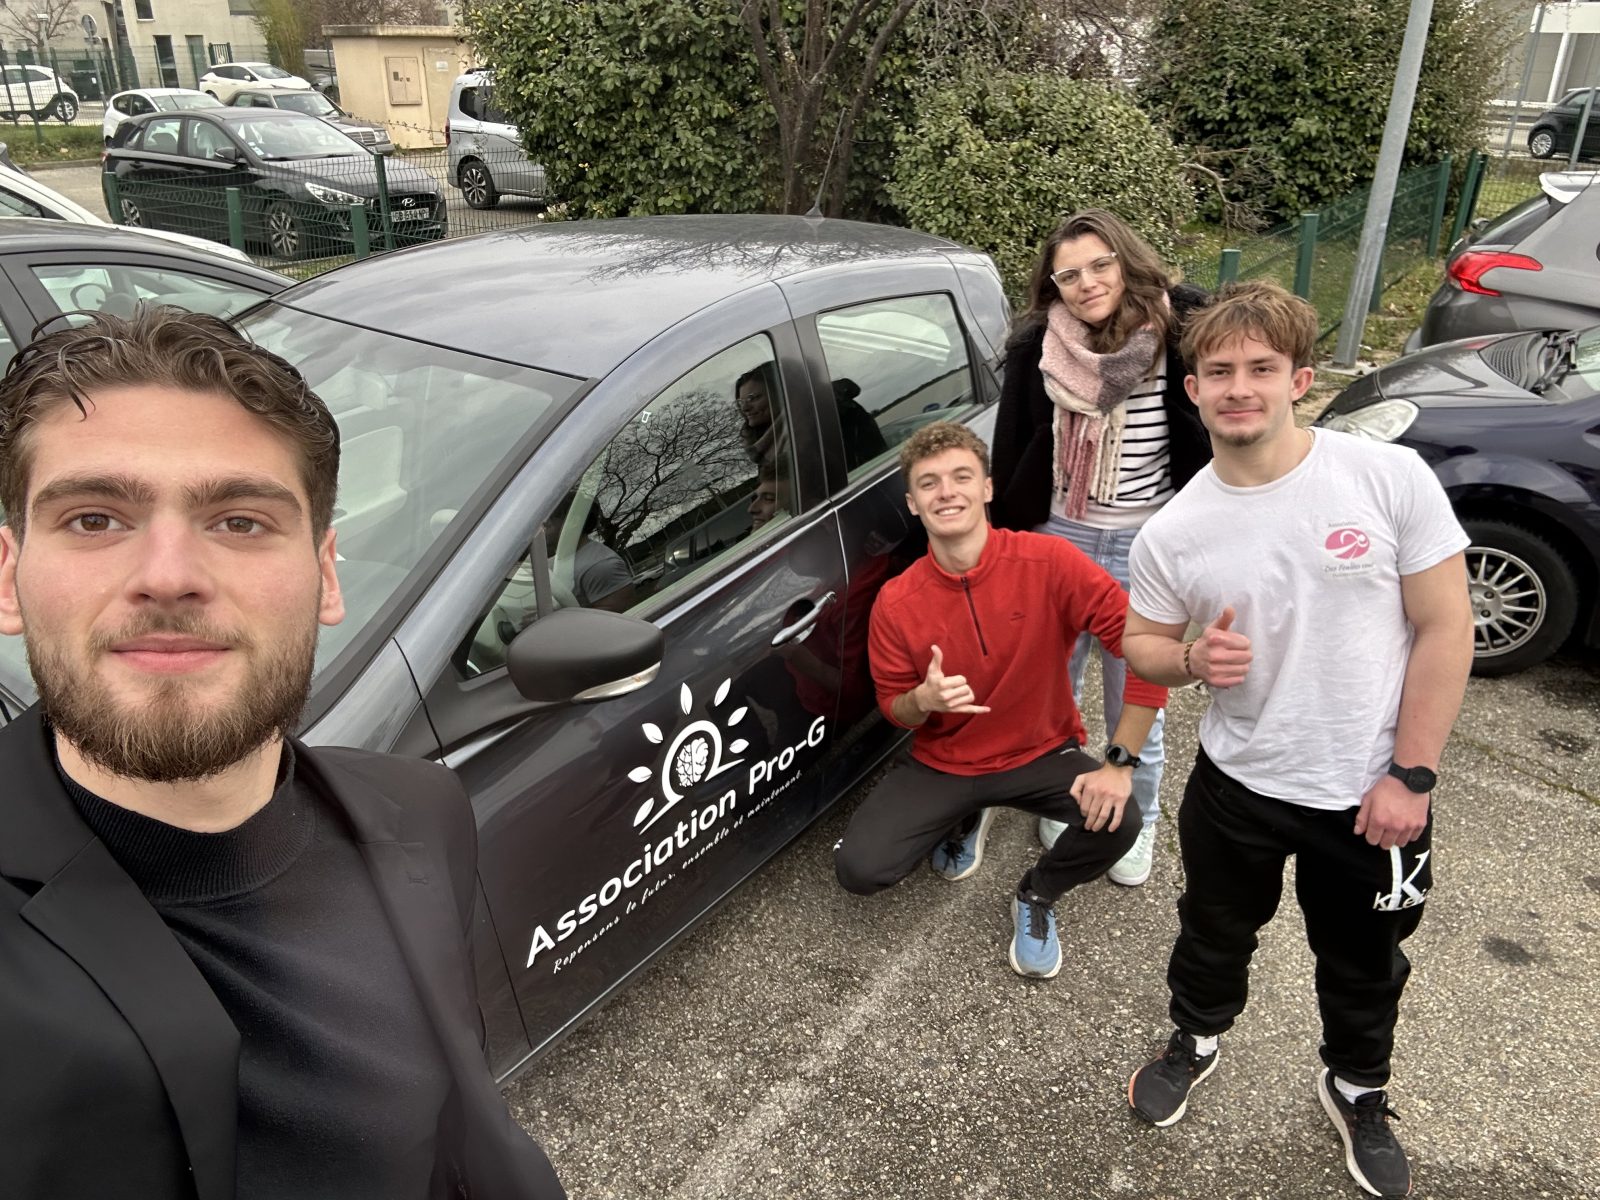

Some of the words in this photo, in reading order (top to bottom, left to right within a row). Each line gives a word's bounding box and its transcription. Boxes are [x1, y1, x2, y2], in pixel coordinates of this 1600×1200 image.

[526, 789, 736, 968] Association
[749, 715, 825, 795] Pro-G
[626, 901, 637, 915] le
[682, 827, 730, 869] ensemble
[733, 814, 744, 829] et
